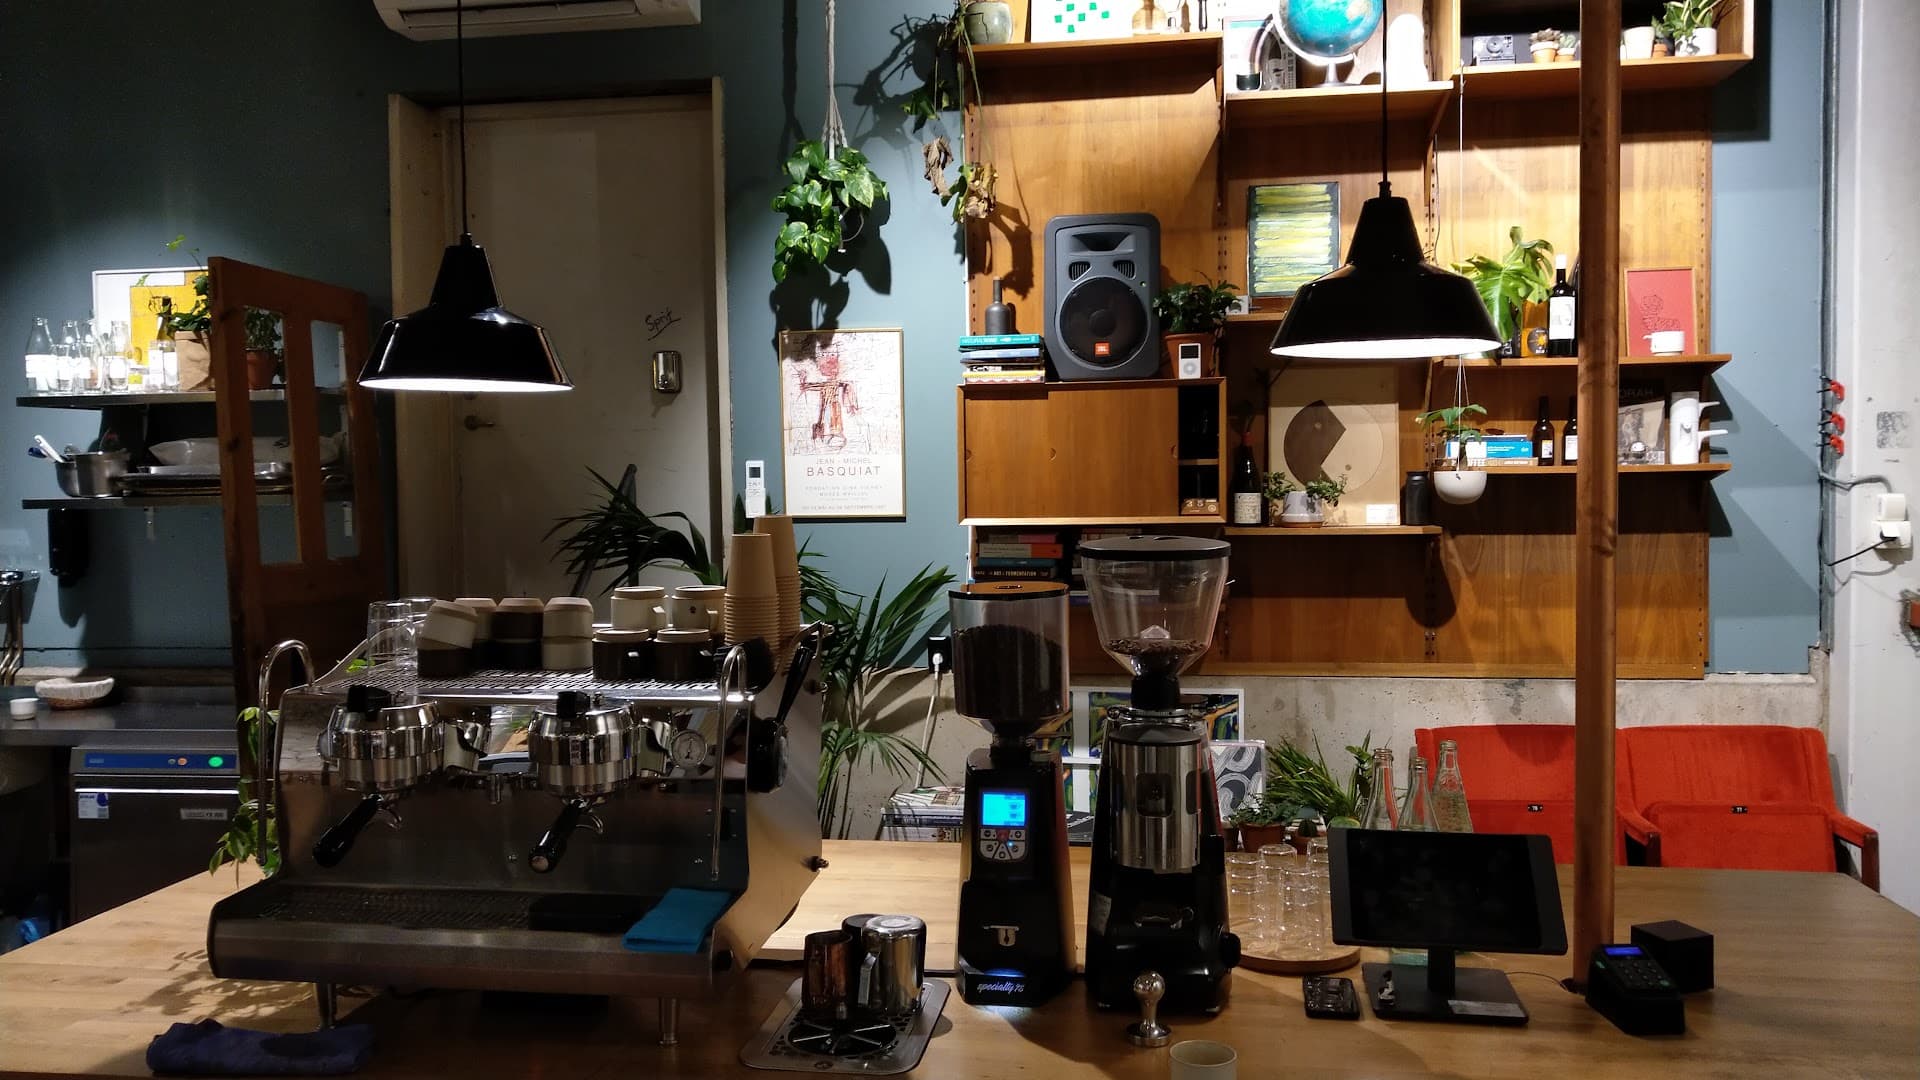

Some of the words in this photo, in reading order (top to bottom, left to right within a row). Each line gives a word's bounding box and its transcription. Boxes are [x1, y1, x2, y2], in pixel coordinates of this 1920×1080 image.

[816, 457, 835, 465] JEAN
[843, 456, 872, 464] MICHEL
[807, 466, 880, 476] BASQUIAT
[977, 981, 1014, 995] specialty
